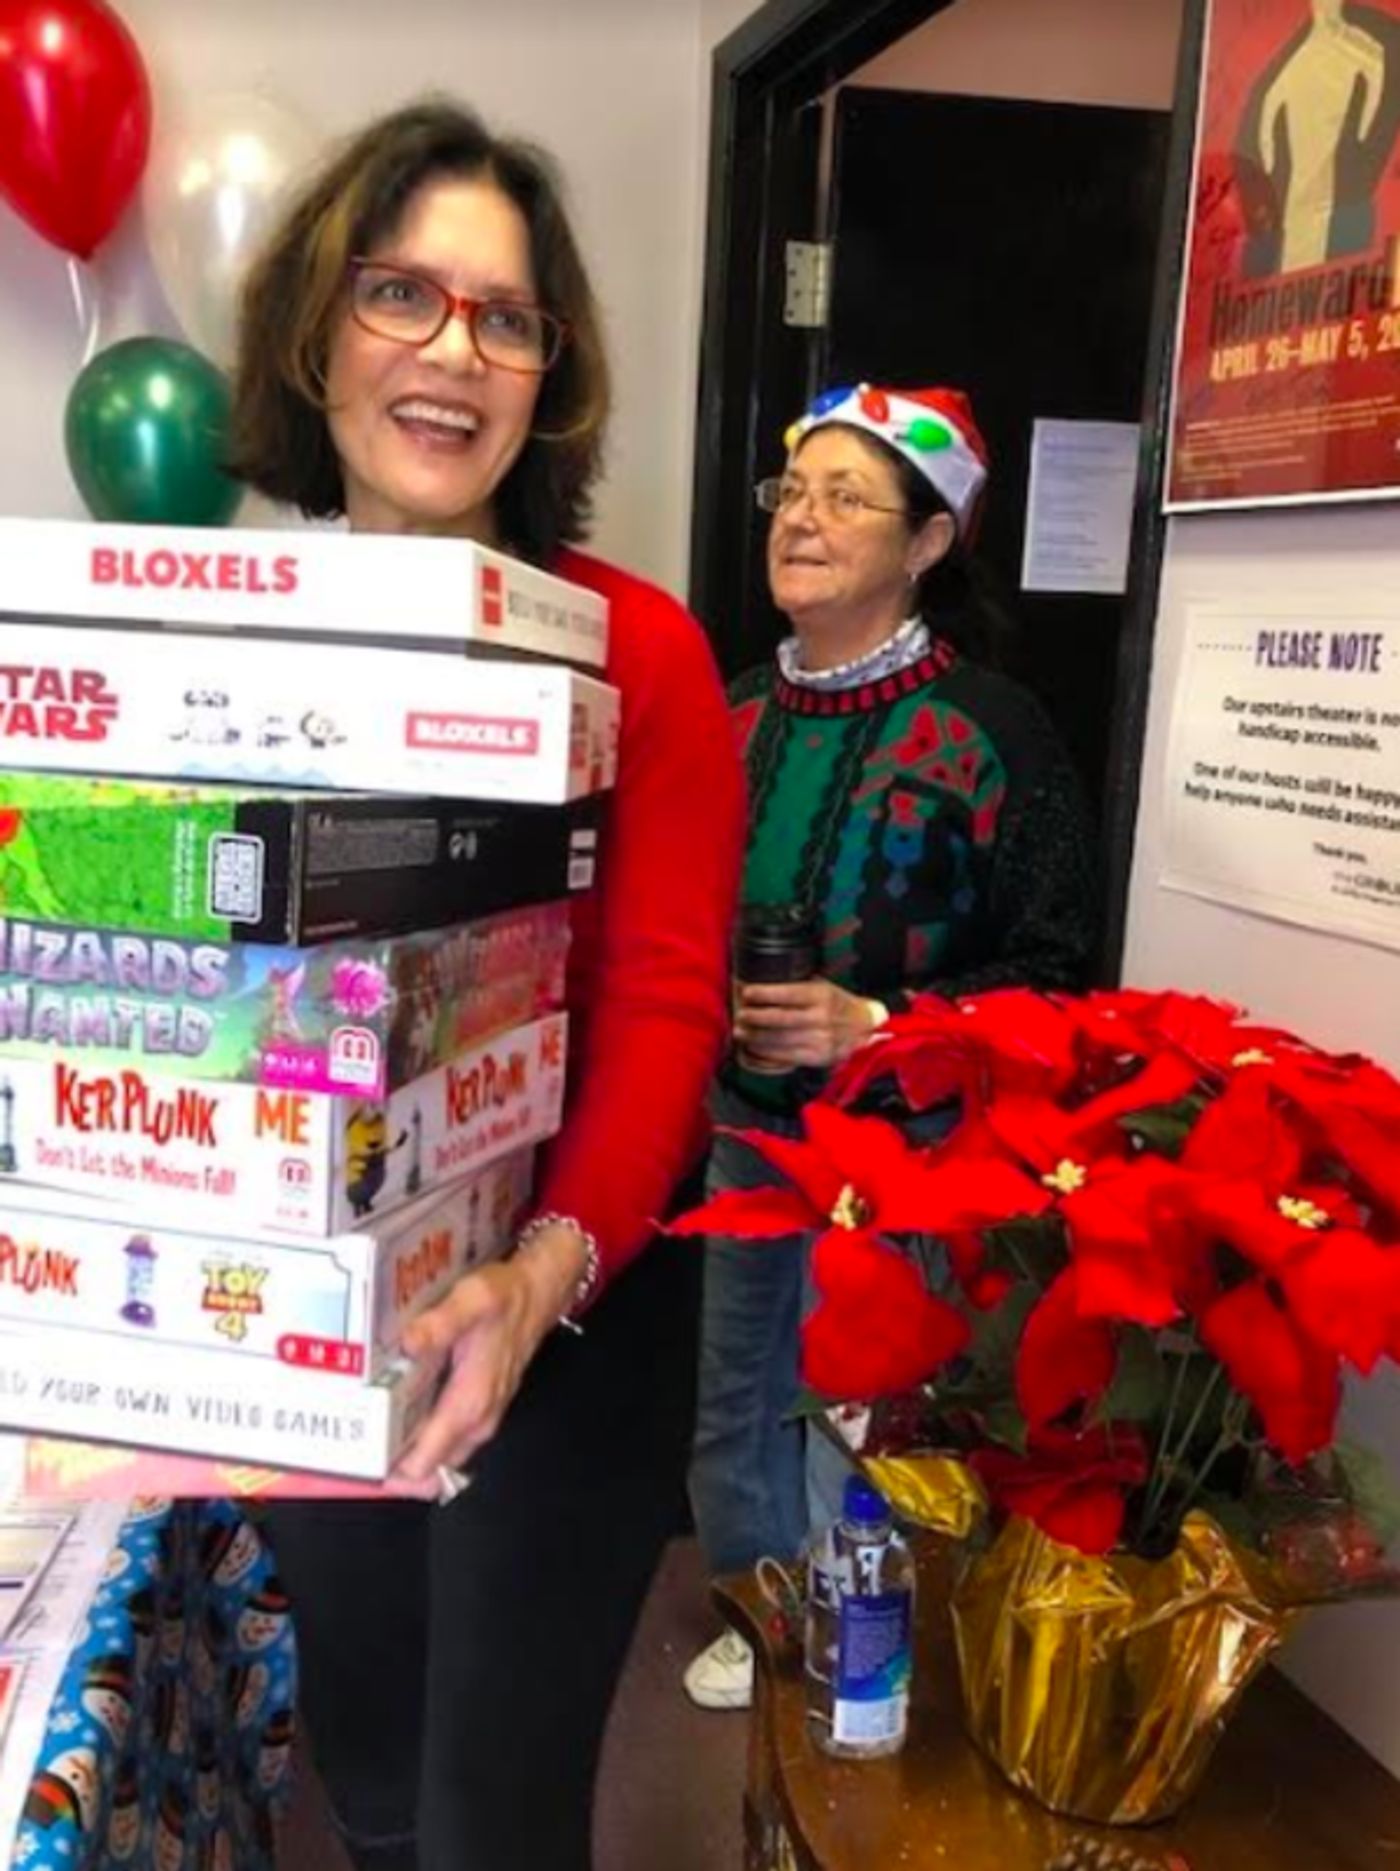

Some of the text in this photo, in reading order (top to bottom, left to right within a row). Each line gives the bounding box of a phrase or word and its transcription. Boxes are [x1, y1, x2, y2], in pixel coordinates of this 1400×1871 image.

[1376, 312, 1400, 352] 20
[91, 547, 299, 593] BLOXELS
[1256, 630, 1384, 673] PLEASE NOTE
[0, 664, 118, 703] TAR
[0, 701, 118, 742] ARS
[1223, 695, 1400, 727] Our upstairs theater is no
[415, 719, 530, 748] BLOXELS
[1238, 720, 1381, 752] handicap accessible.
[1194, 761, 1219, 778] One
[1222, 765, 1237, 779] of
[1238, 769, 1261, 783] our
[1263, 770, 1301, 791] hosts
[1304, 777, 1332, 795] will
[1334, 780, 1352, 799] be
[1185, 781, 1400, 832] help anyone who needs assistan
[0, 920, 229, 998] IZARDS
[254, 1089, 309, 1146] ME
[111, 1153, 136, 1180] the
[0, 1234, 80, 1297] PLUNK
[203, 1260, 269, 1295] TOY
[215, 1310, 248, 1341] 4
[40, 1377, 101, 1405] YOUR
[115, 1386, 170, 1415] OWN
[273, 1408, 366, 1441] GAMES
